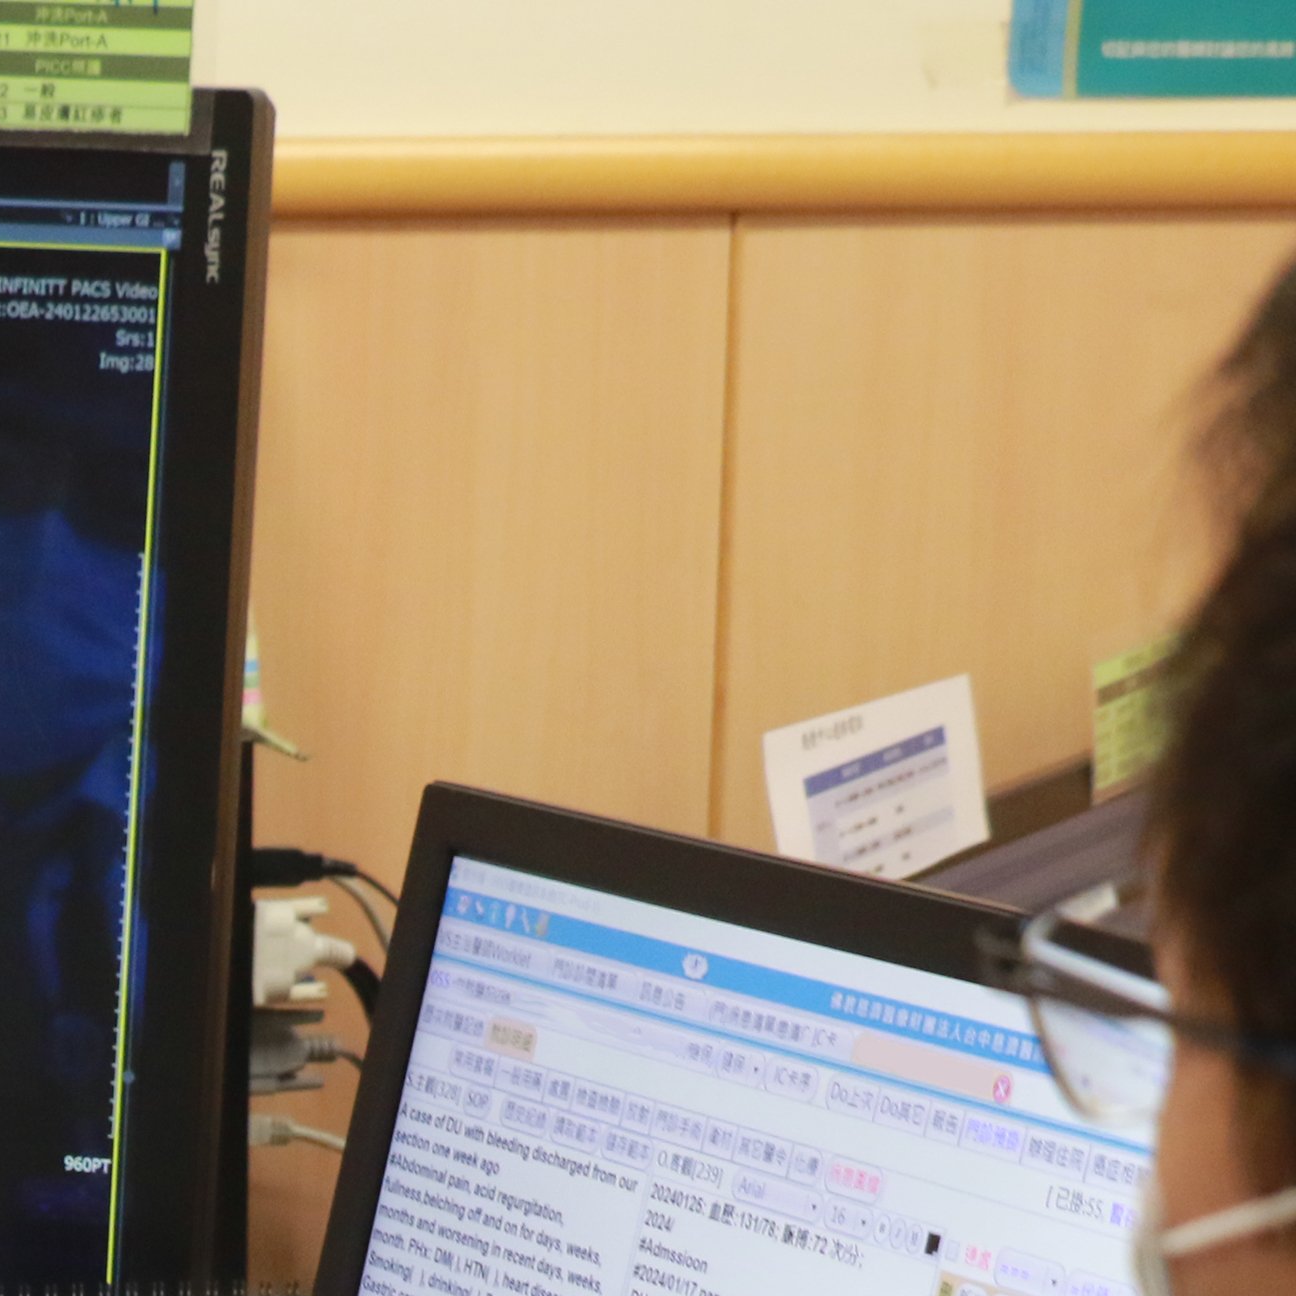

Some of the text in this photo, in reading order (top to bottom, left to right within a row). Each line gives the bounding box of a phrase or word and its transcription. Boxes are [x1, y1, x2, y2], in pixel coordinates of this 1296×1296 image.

[72, 279, 111, 297] PACS
[116, 281, 158, 300] Video
[64, 1155, 112, 1174] 960PT
[394, 1129, 500, 1177] section one week ago
[409, 1107, 639, 1192] case of DU with bleeding discharged from our
[389, 1152, 447, 1184] #Abdominal
[473, 1181, 496, 1201] acid
[379, 1203, 535, 1269] months and worsening recent
[467, 1205, 535, 1242] off and on for
[502, 1275, 530, 1295] heart
